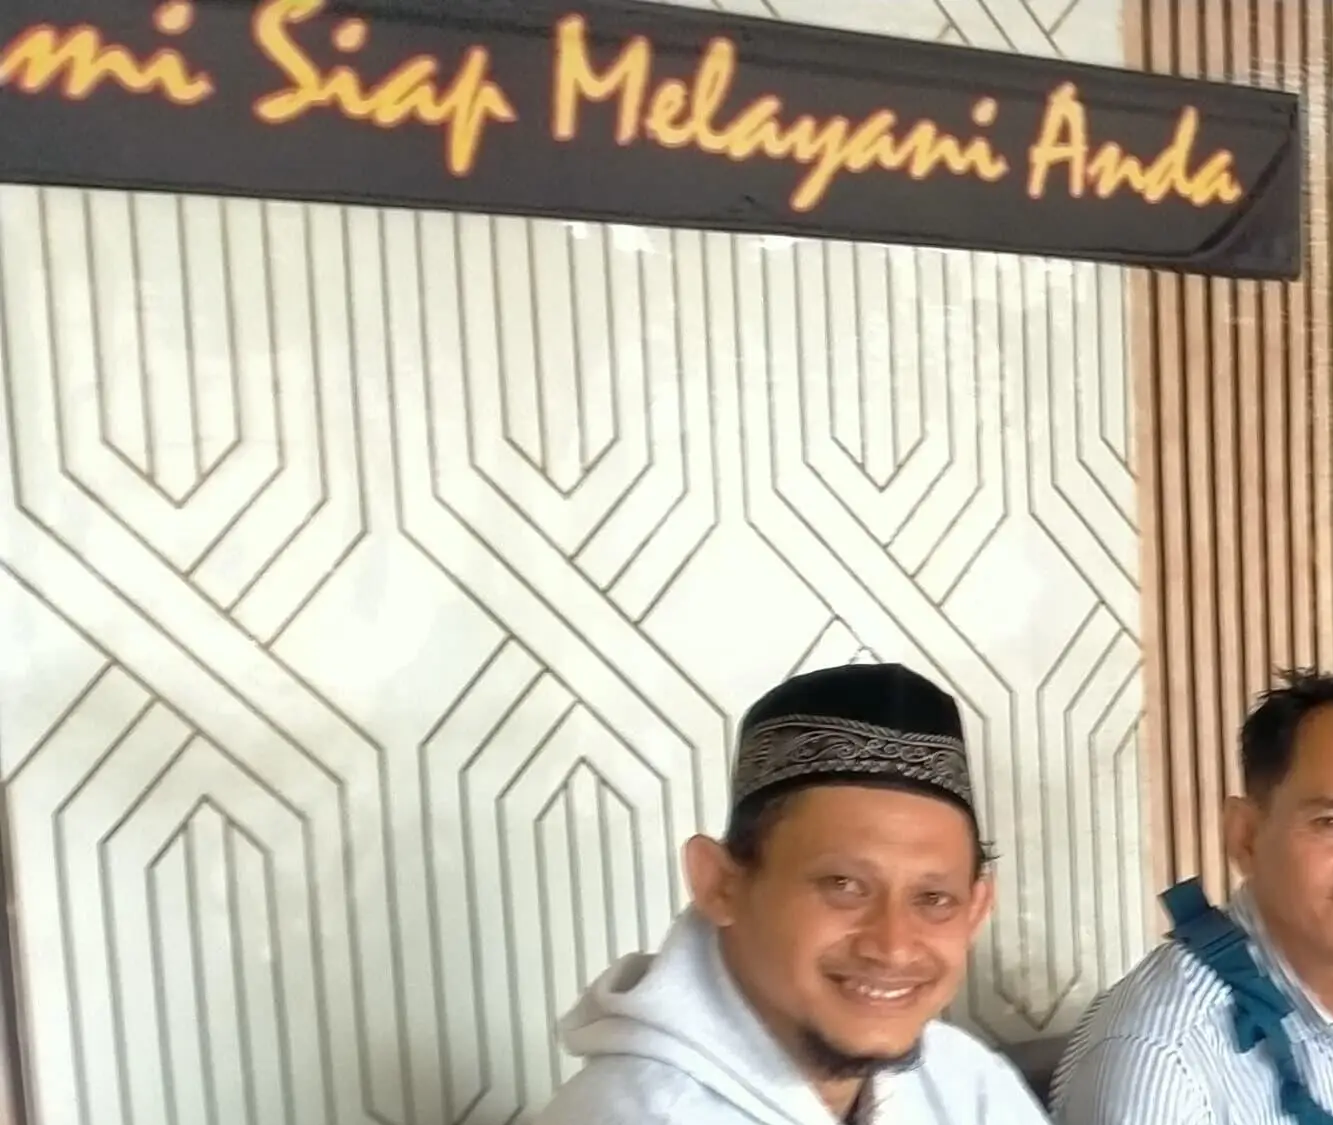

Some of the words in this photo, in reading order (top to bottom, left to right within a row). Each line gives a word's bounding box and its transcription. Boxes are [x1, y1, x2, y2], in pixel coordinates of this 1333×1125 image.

[253, 0, 514, 176] Siap
[552, 14, 1006, 211] Melayani
[1028, 86, 1242, 206] Anda
